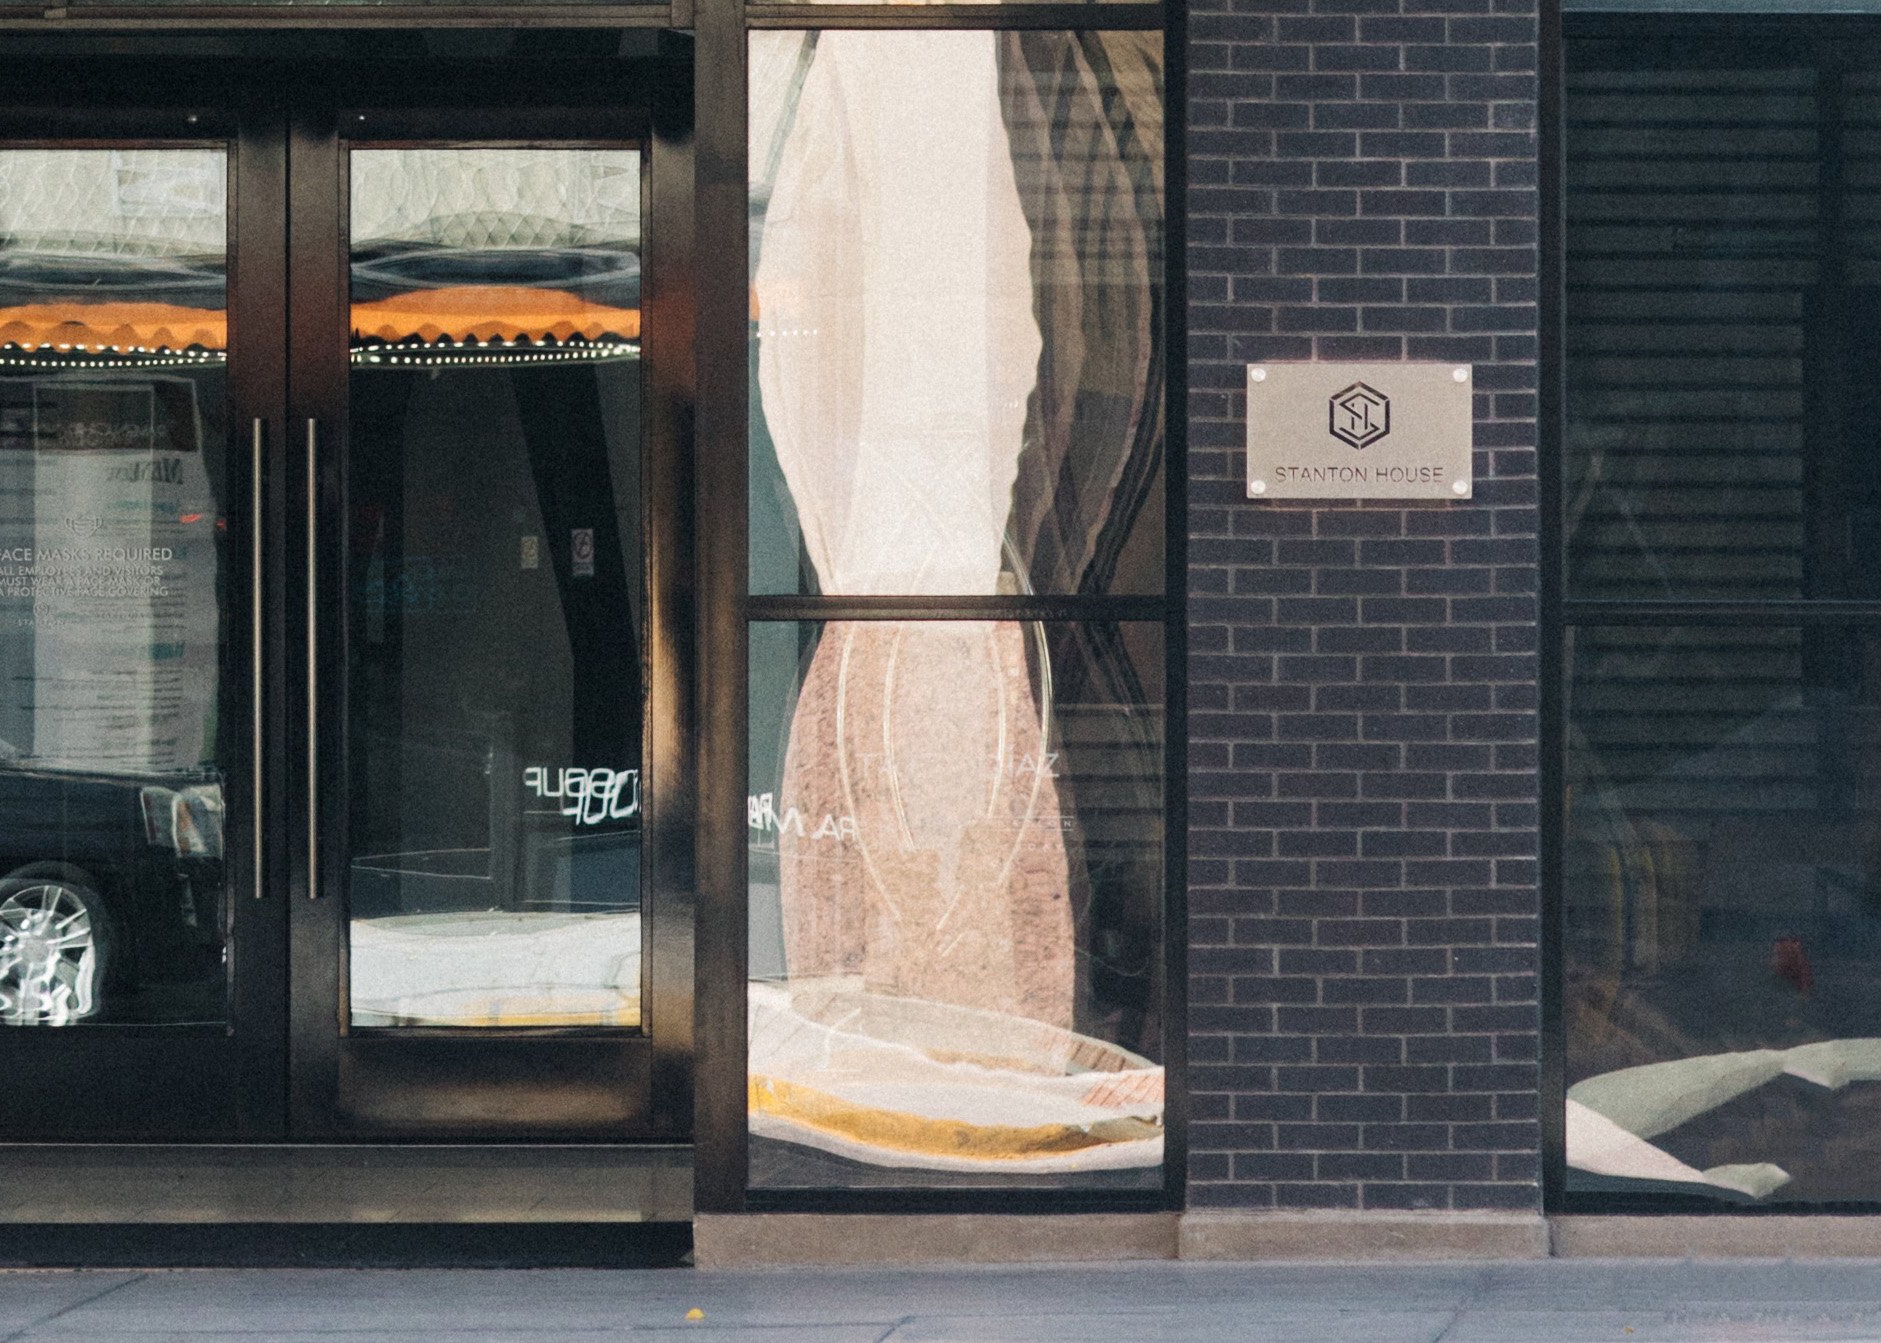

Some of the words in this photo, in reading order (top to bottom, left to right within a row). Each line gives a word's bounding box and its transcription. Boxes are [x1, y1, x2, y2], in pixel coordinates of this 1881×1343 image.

[1275, 466, 1367, 483] STANTON
[1375, 466, 1444, 483] HOUSE
[37, 547, 90, 561] MASKS
[96, 547, 173, 561] REQUIRED
[18, 565, 82, 576] EMPLOYEES
[84, 565, 111, 576] AND
[114, 565, 164, 576] VISITORS
[30, 576, 62, 586] WEAR
[77, 576, 105, 586] FACE
[108, 576, 141, 586] MASK
[144, 576, 161, 586] OR
[8, 586, 73, 597] PROTECTIVE
[77, 586, 106, 597] FACE
[108, 586, 169, 597] COVERING
